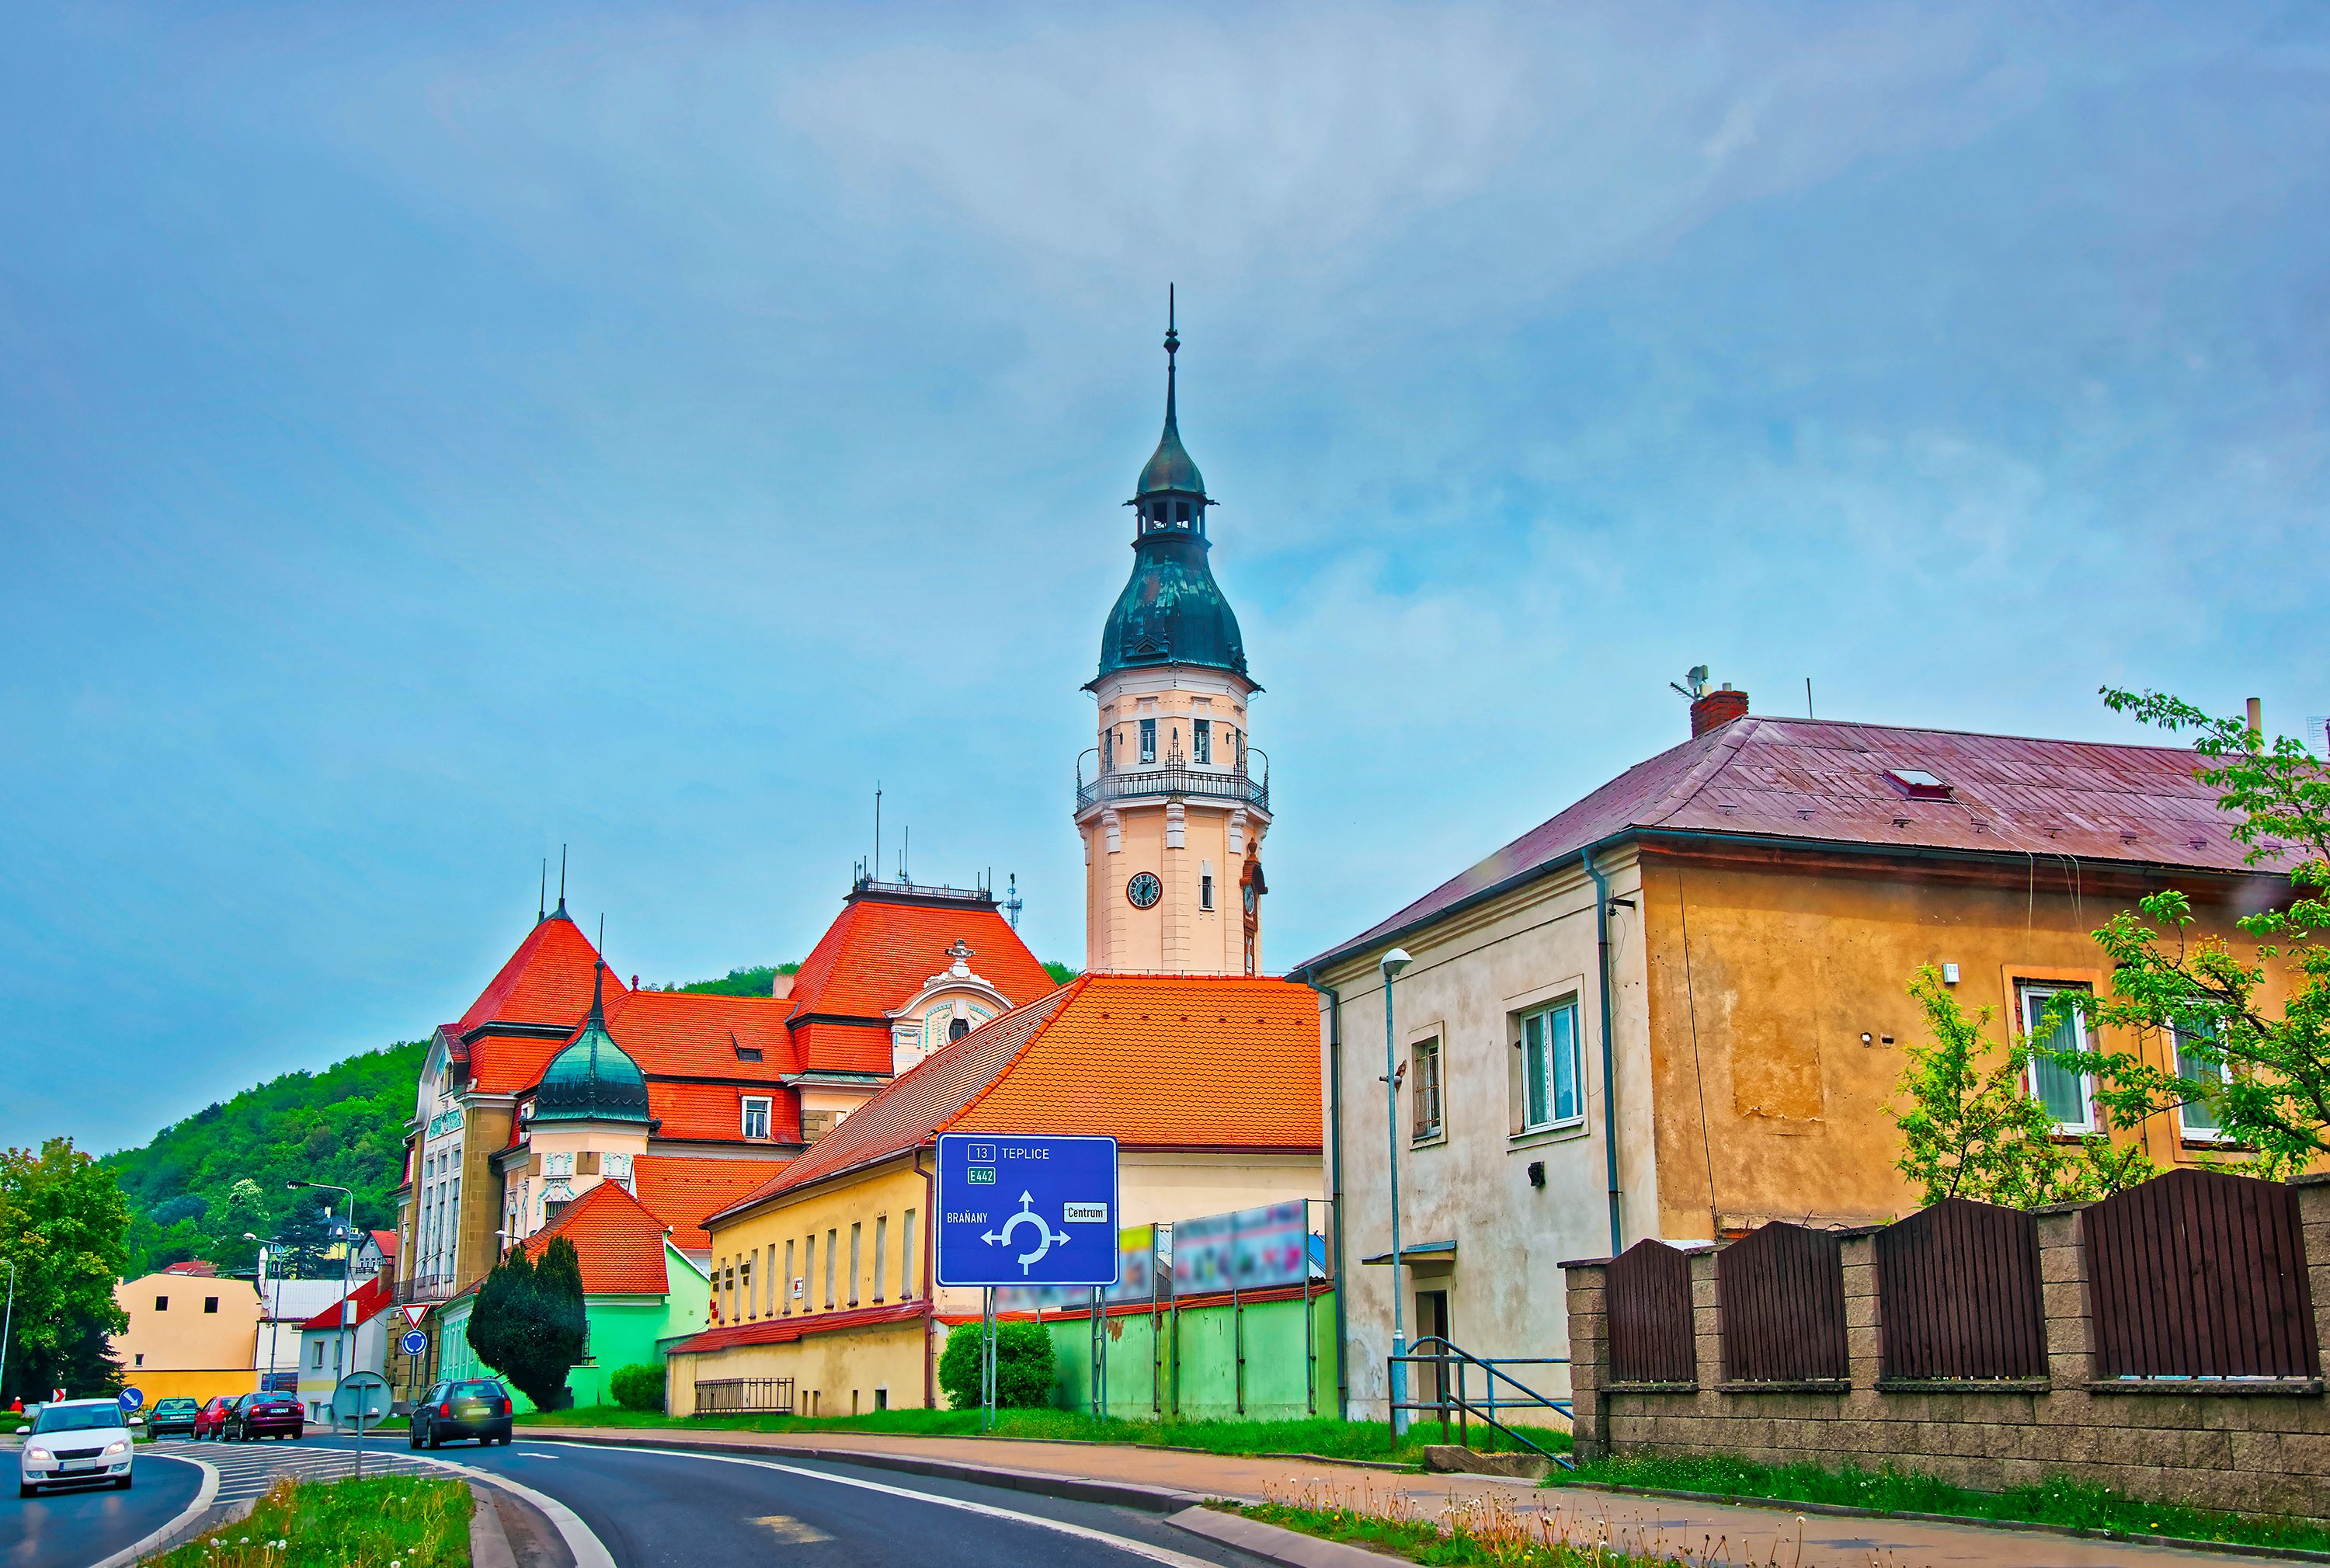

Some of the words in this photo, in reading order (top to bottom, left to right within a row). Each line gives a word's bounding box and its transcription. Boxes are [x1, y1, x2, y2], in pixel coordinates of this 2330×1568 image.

[976, 1147, 988, 1159] 13
[1002, 1148, 1049, 1159] TEPLICE
[947, 1209, 988, 1223] BRAŇANY
[1068, 1207, 1103, 1218] Centrum
